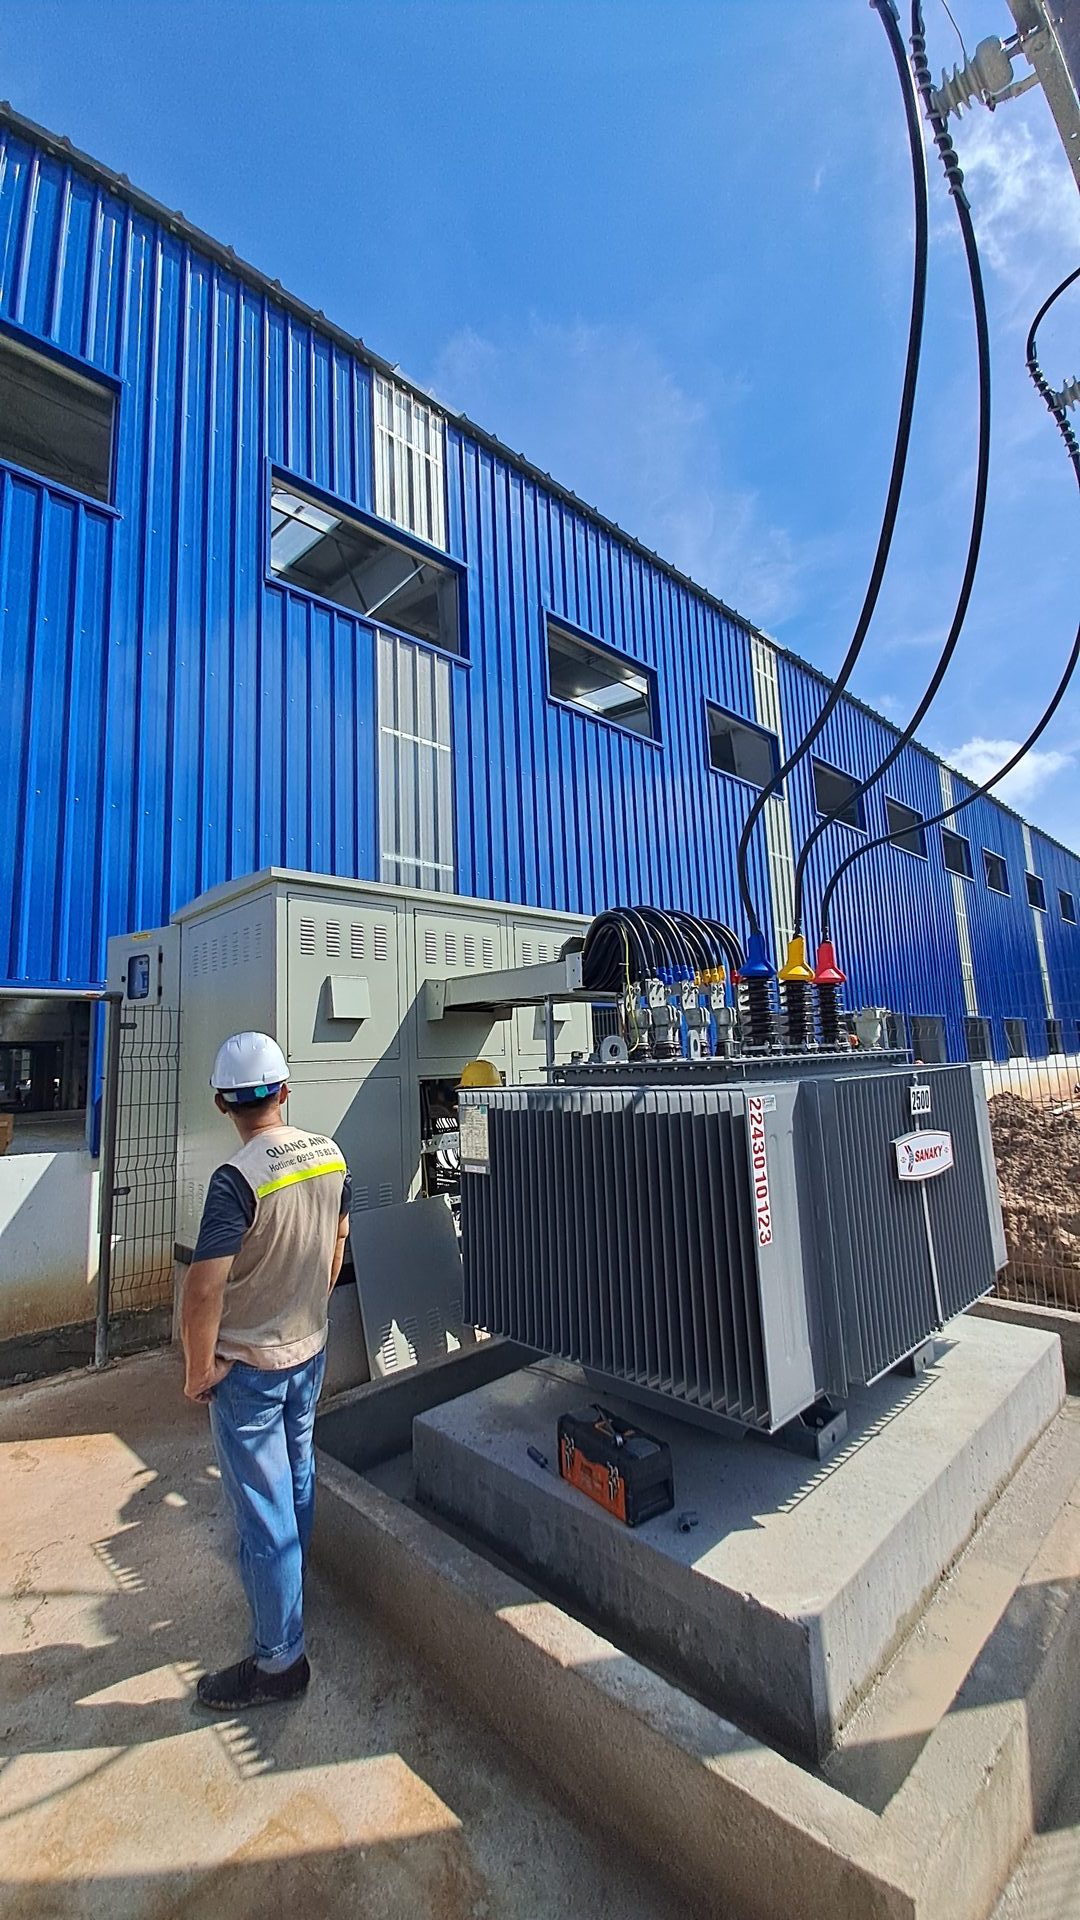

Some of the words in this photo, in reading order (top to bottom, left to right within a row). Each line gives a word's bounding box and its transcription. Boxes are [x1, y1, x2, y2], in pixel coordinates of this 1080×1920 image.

[911, 1089, 930, 1111] 2500
[265, 1139, 307, 1158] QUANG
[308, 1136, 328, 1147] ANH
[914, 1145, 943, 1163] SANAKY
[268, 1158, 297, 1172] Hotline:
[296, 1151, 315, 1163] 0919
[749, 1097, 772, 1244] 2243010123
